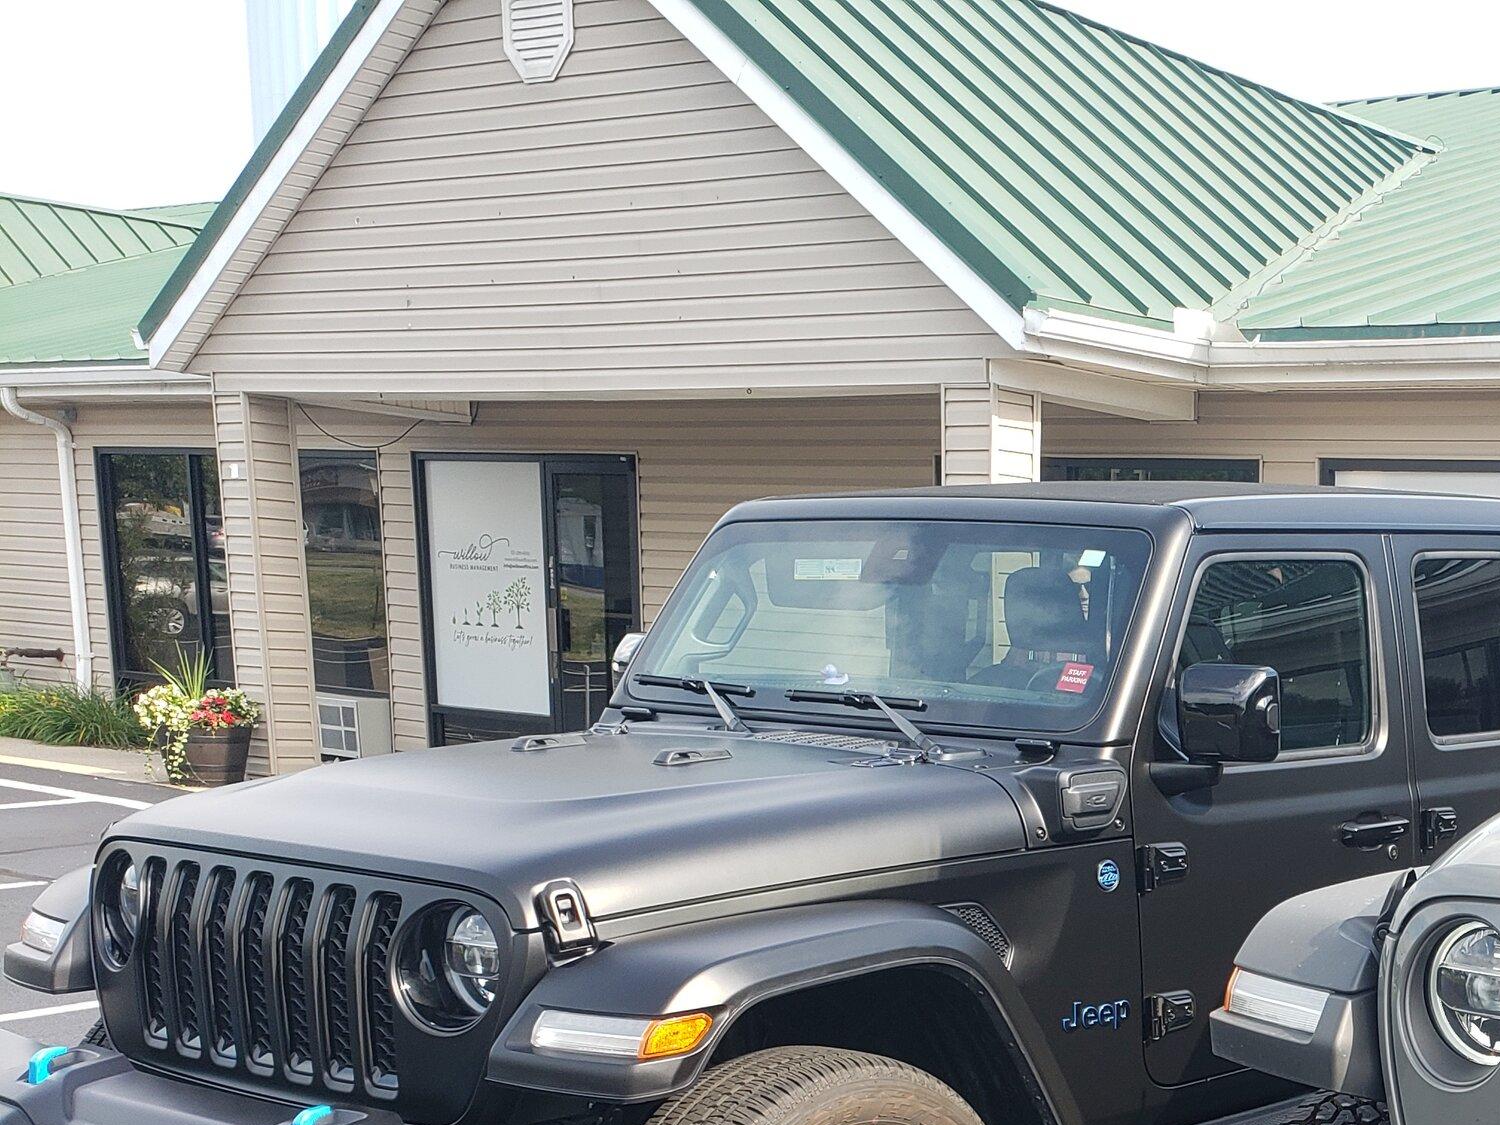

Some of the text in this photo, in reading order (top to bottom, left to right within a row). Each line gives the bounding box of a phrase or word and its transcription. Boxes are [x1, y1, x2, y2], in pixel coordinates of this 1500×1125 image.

[438, 533, 509, 561] willow
[1060, 676, 1088, 685] PARKING
[1061, 999, 1131, 1033] Jeep
